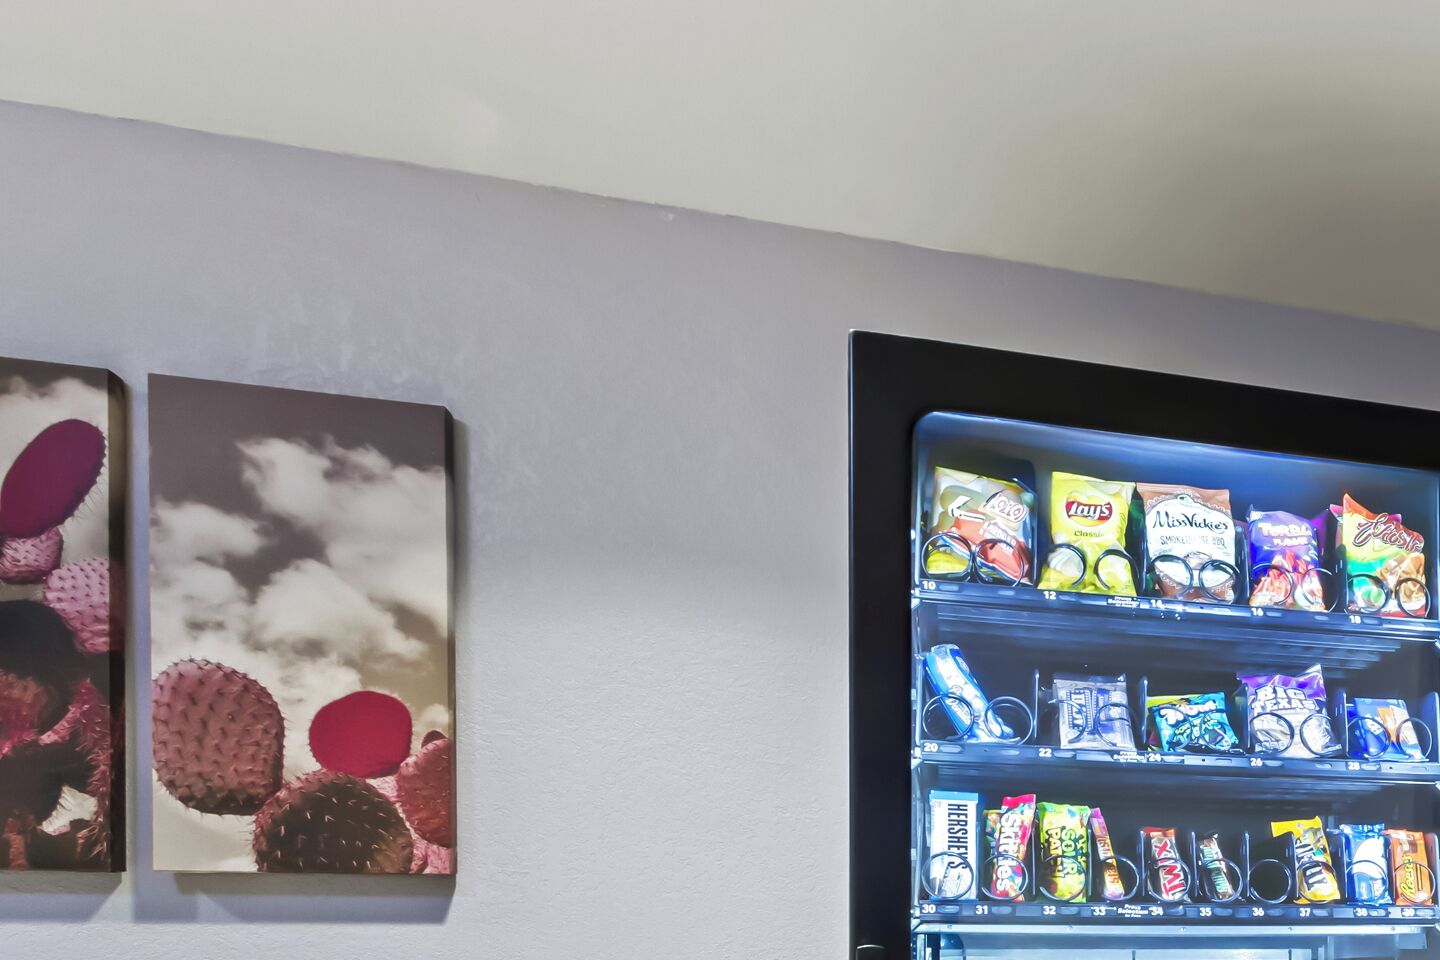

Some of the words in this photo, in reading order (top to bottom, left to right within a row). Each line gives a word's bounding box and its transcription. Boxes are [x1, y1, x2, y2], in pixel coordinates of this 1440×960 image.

[1069, 500, 1111, 520] Lay's
[922, 581, 936, 590] 10
[1043, 591, 1057, 600] 12
[1251, 608, 1264, 617] 16
[1349, 616, 1361, 624] 18
[1255, 685, 1307, 701] BIG
[1251, 698, 1320, 717] TEXAS
[924, 743, 938, 752] 20
[1038, 748, 1052, 757] 22
[1148, 753, 1161, 762] 24
[1250, 758, 1263, 767] 26
[1347, 761, 1360, 770] 28
[1061, 829, 1078, 876] SOUR
[1154, 839, 1186, 897] TWIX
[922, 905, 936, 914] 30
[975, 905, 989, 915] 31
[1043, 906, 1056, 915] 32
[1093, 907, 1106, 915] 33
[1151, 907, 1164, 916] 34
[1200, 907, 1212, 916] 35
[1252, 907, 1265, 916] 36
[1299, 907, 1311, 917] 37
[1356, 907, 1368, 917] 38
